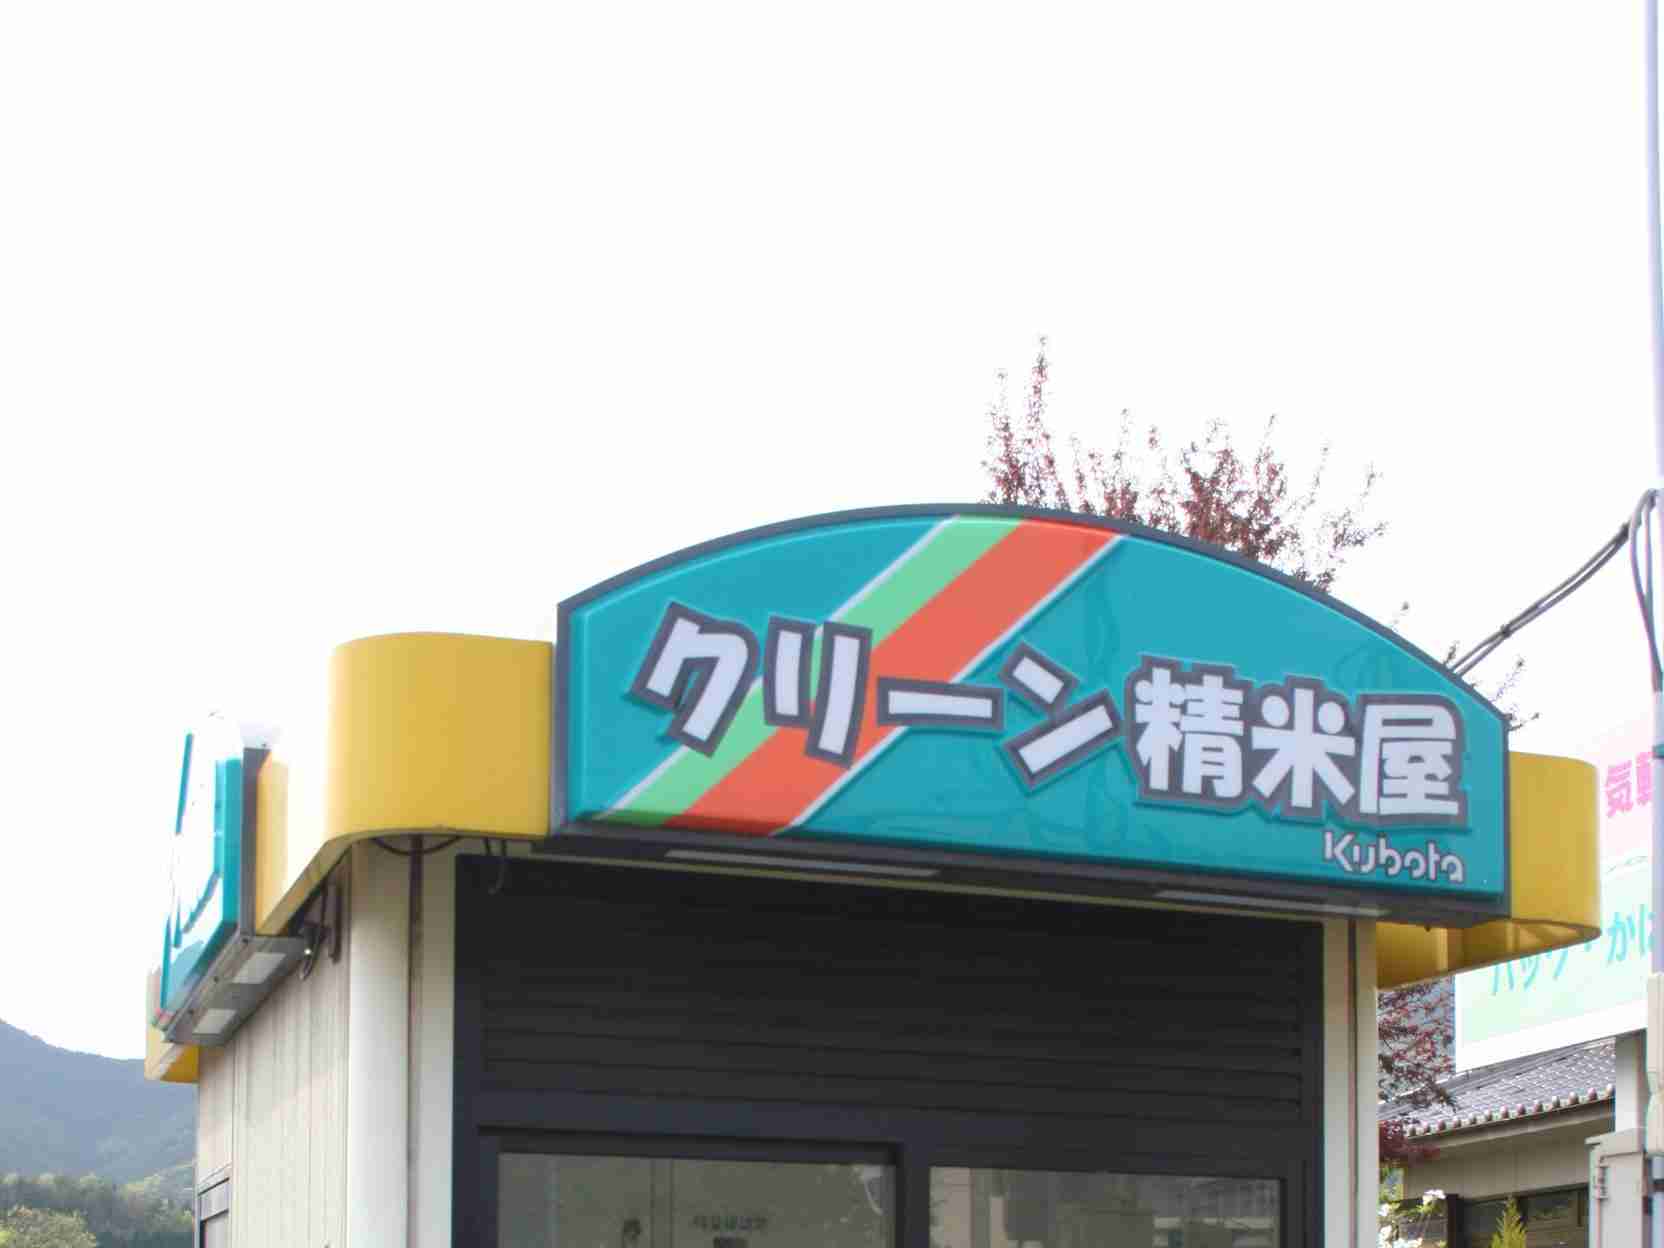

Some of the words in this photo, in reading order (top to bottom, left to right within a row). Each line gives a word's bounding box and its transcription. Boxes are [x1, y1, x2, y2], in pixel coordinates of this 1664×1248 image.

[640, 608, 1463, 820] クリーン精米屋
[1323, 830, 1465, 885] Kubota
